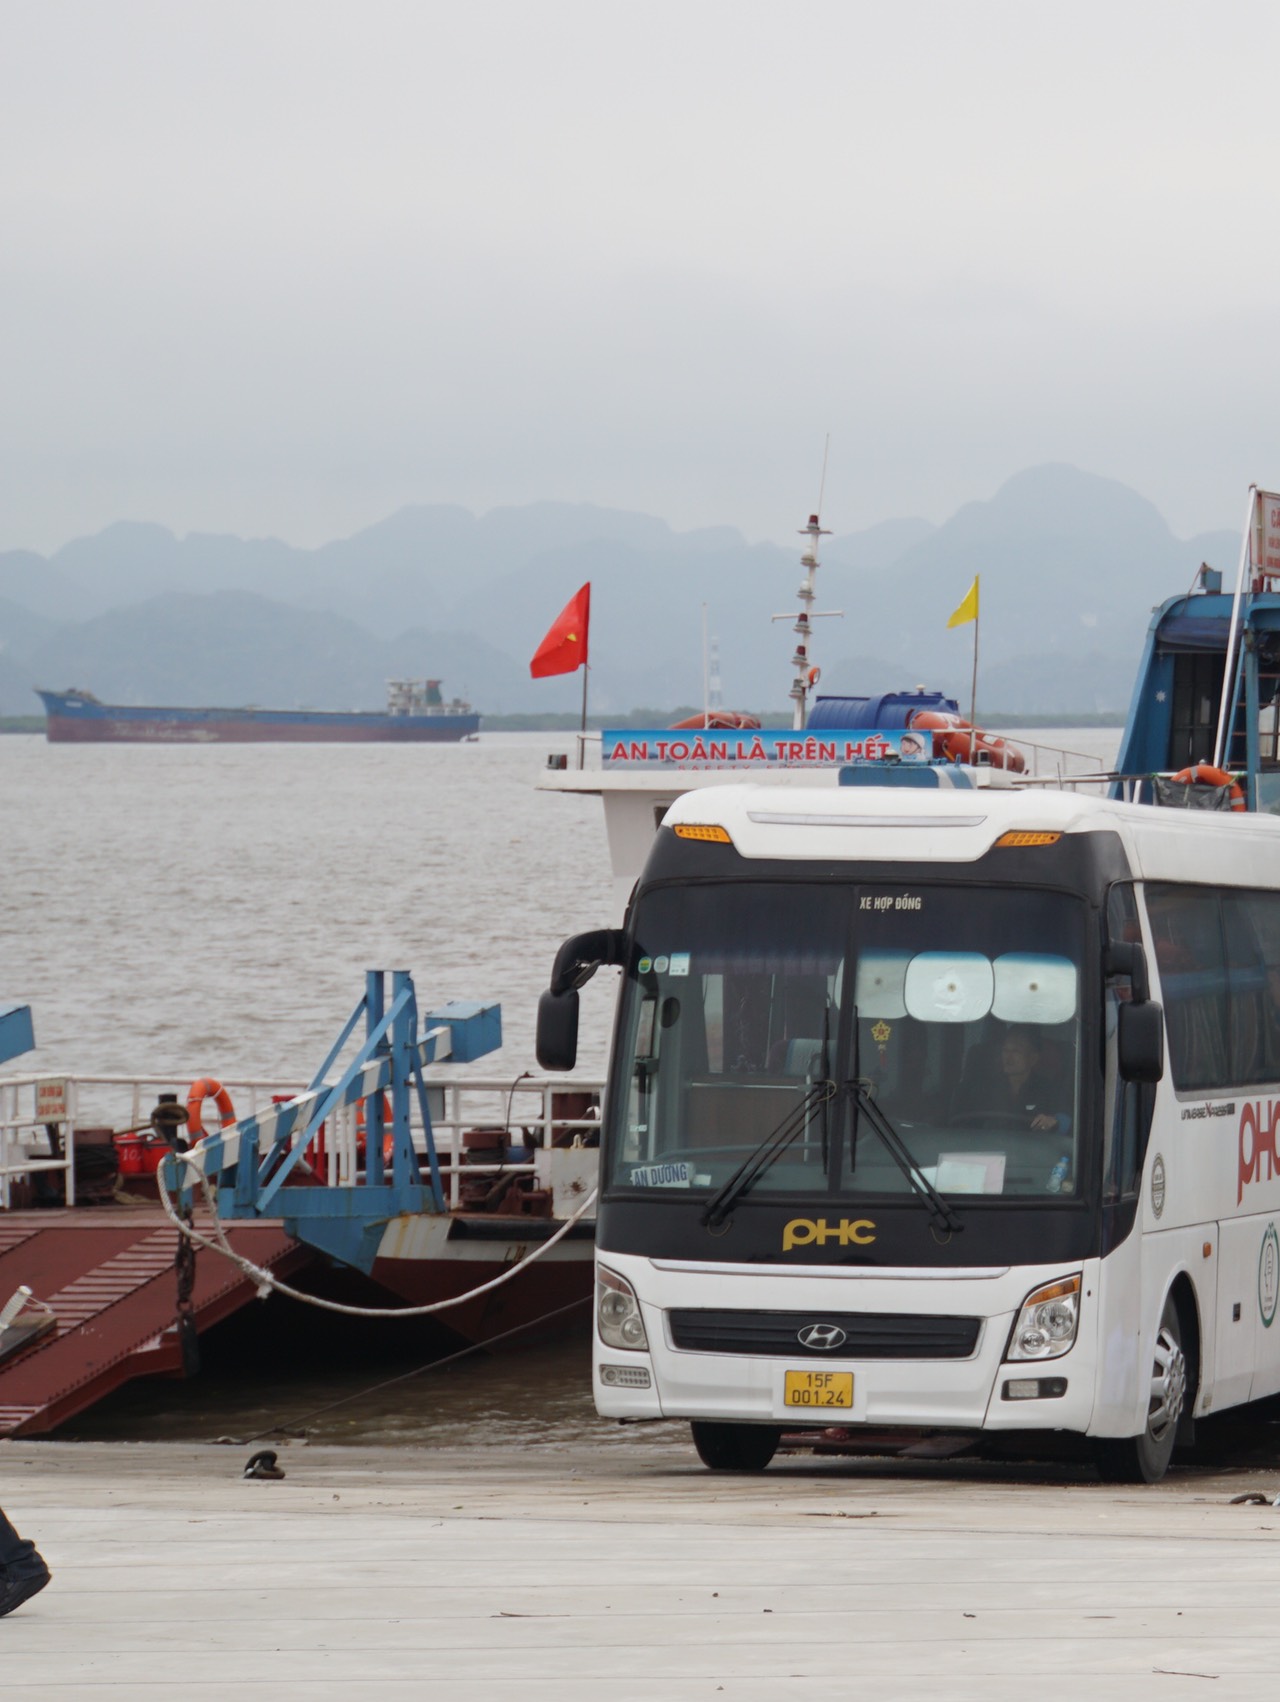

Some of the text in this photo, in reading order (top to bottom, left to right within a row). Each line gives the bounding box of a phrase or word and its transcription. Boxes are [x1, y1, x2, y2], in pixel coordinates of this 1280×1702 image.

[611, 733, 890, 760] AN TOÀN LÀ TRÊN HẾT
[860, 896, 872, 909] XE
[874, 896, 893, 912] HỢP
[634, 1169, 649, 1187] AN
[806, 1373, 833, 1388] 15F
[792, 1389, 844, 1405] 001.24
